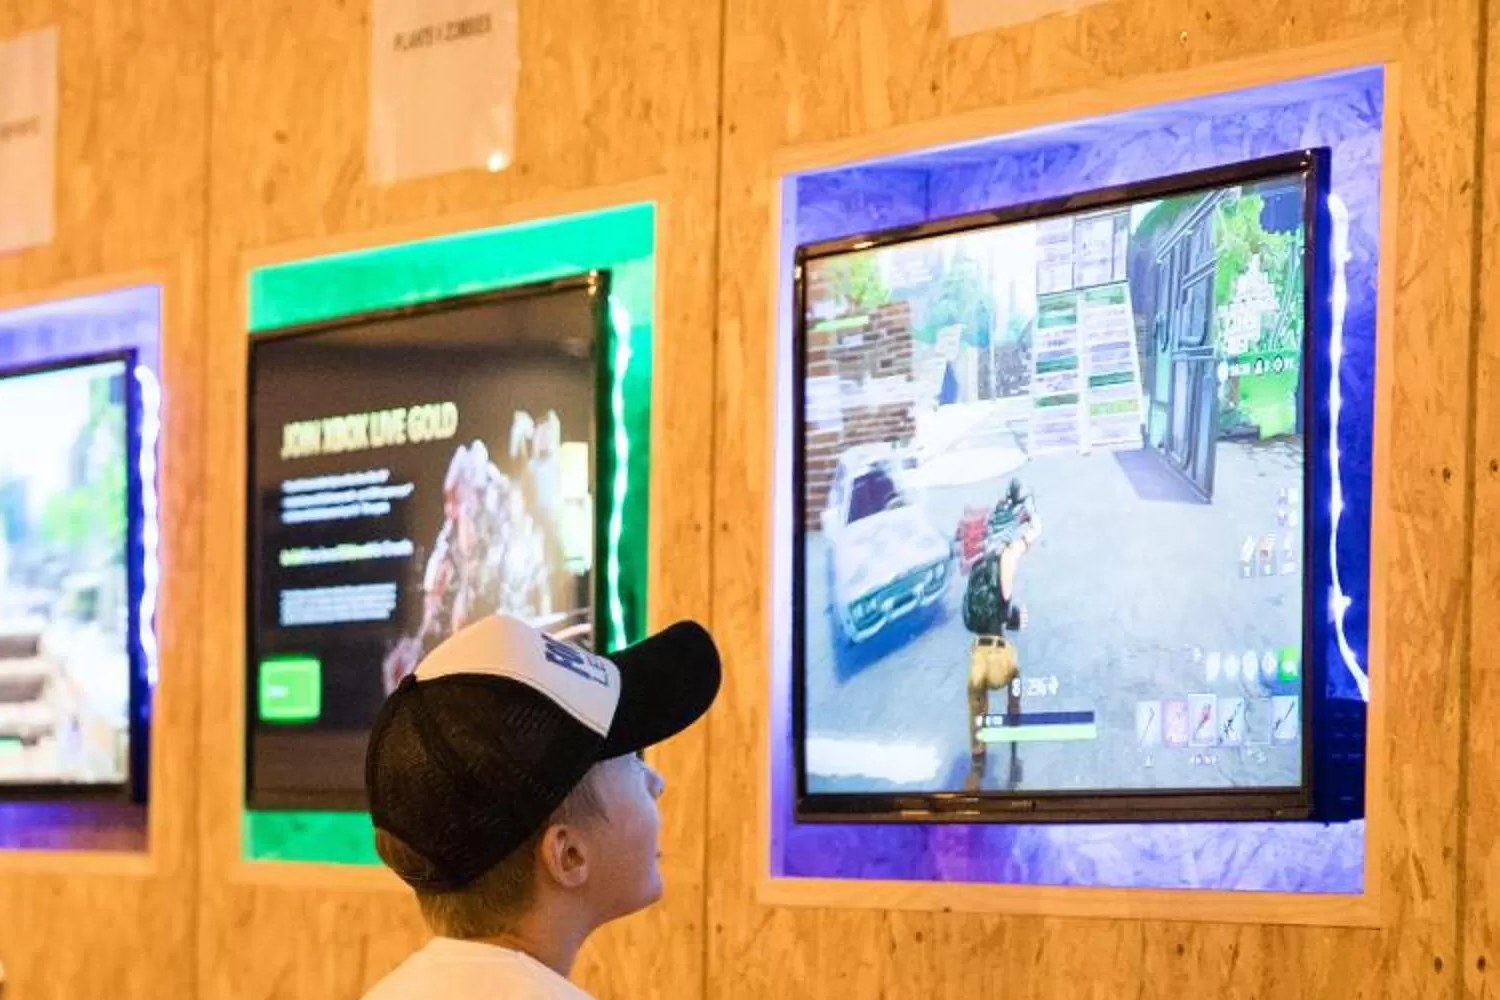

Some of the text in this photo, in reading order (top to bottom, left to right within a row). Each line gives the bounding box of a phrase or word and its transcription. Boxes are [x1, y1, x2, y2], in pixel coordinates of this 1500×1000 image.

[280, 401, 458, 461] JOIN XBOX LIVE GOLD
